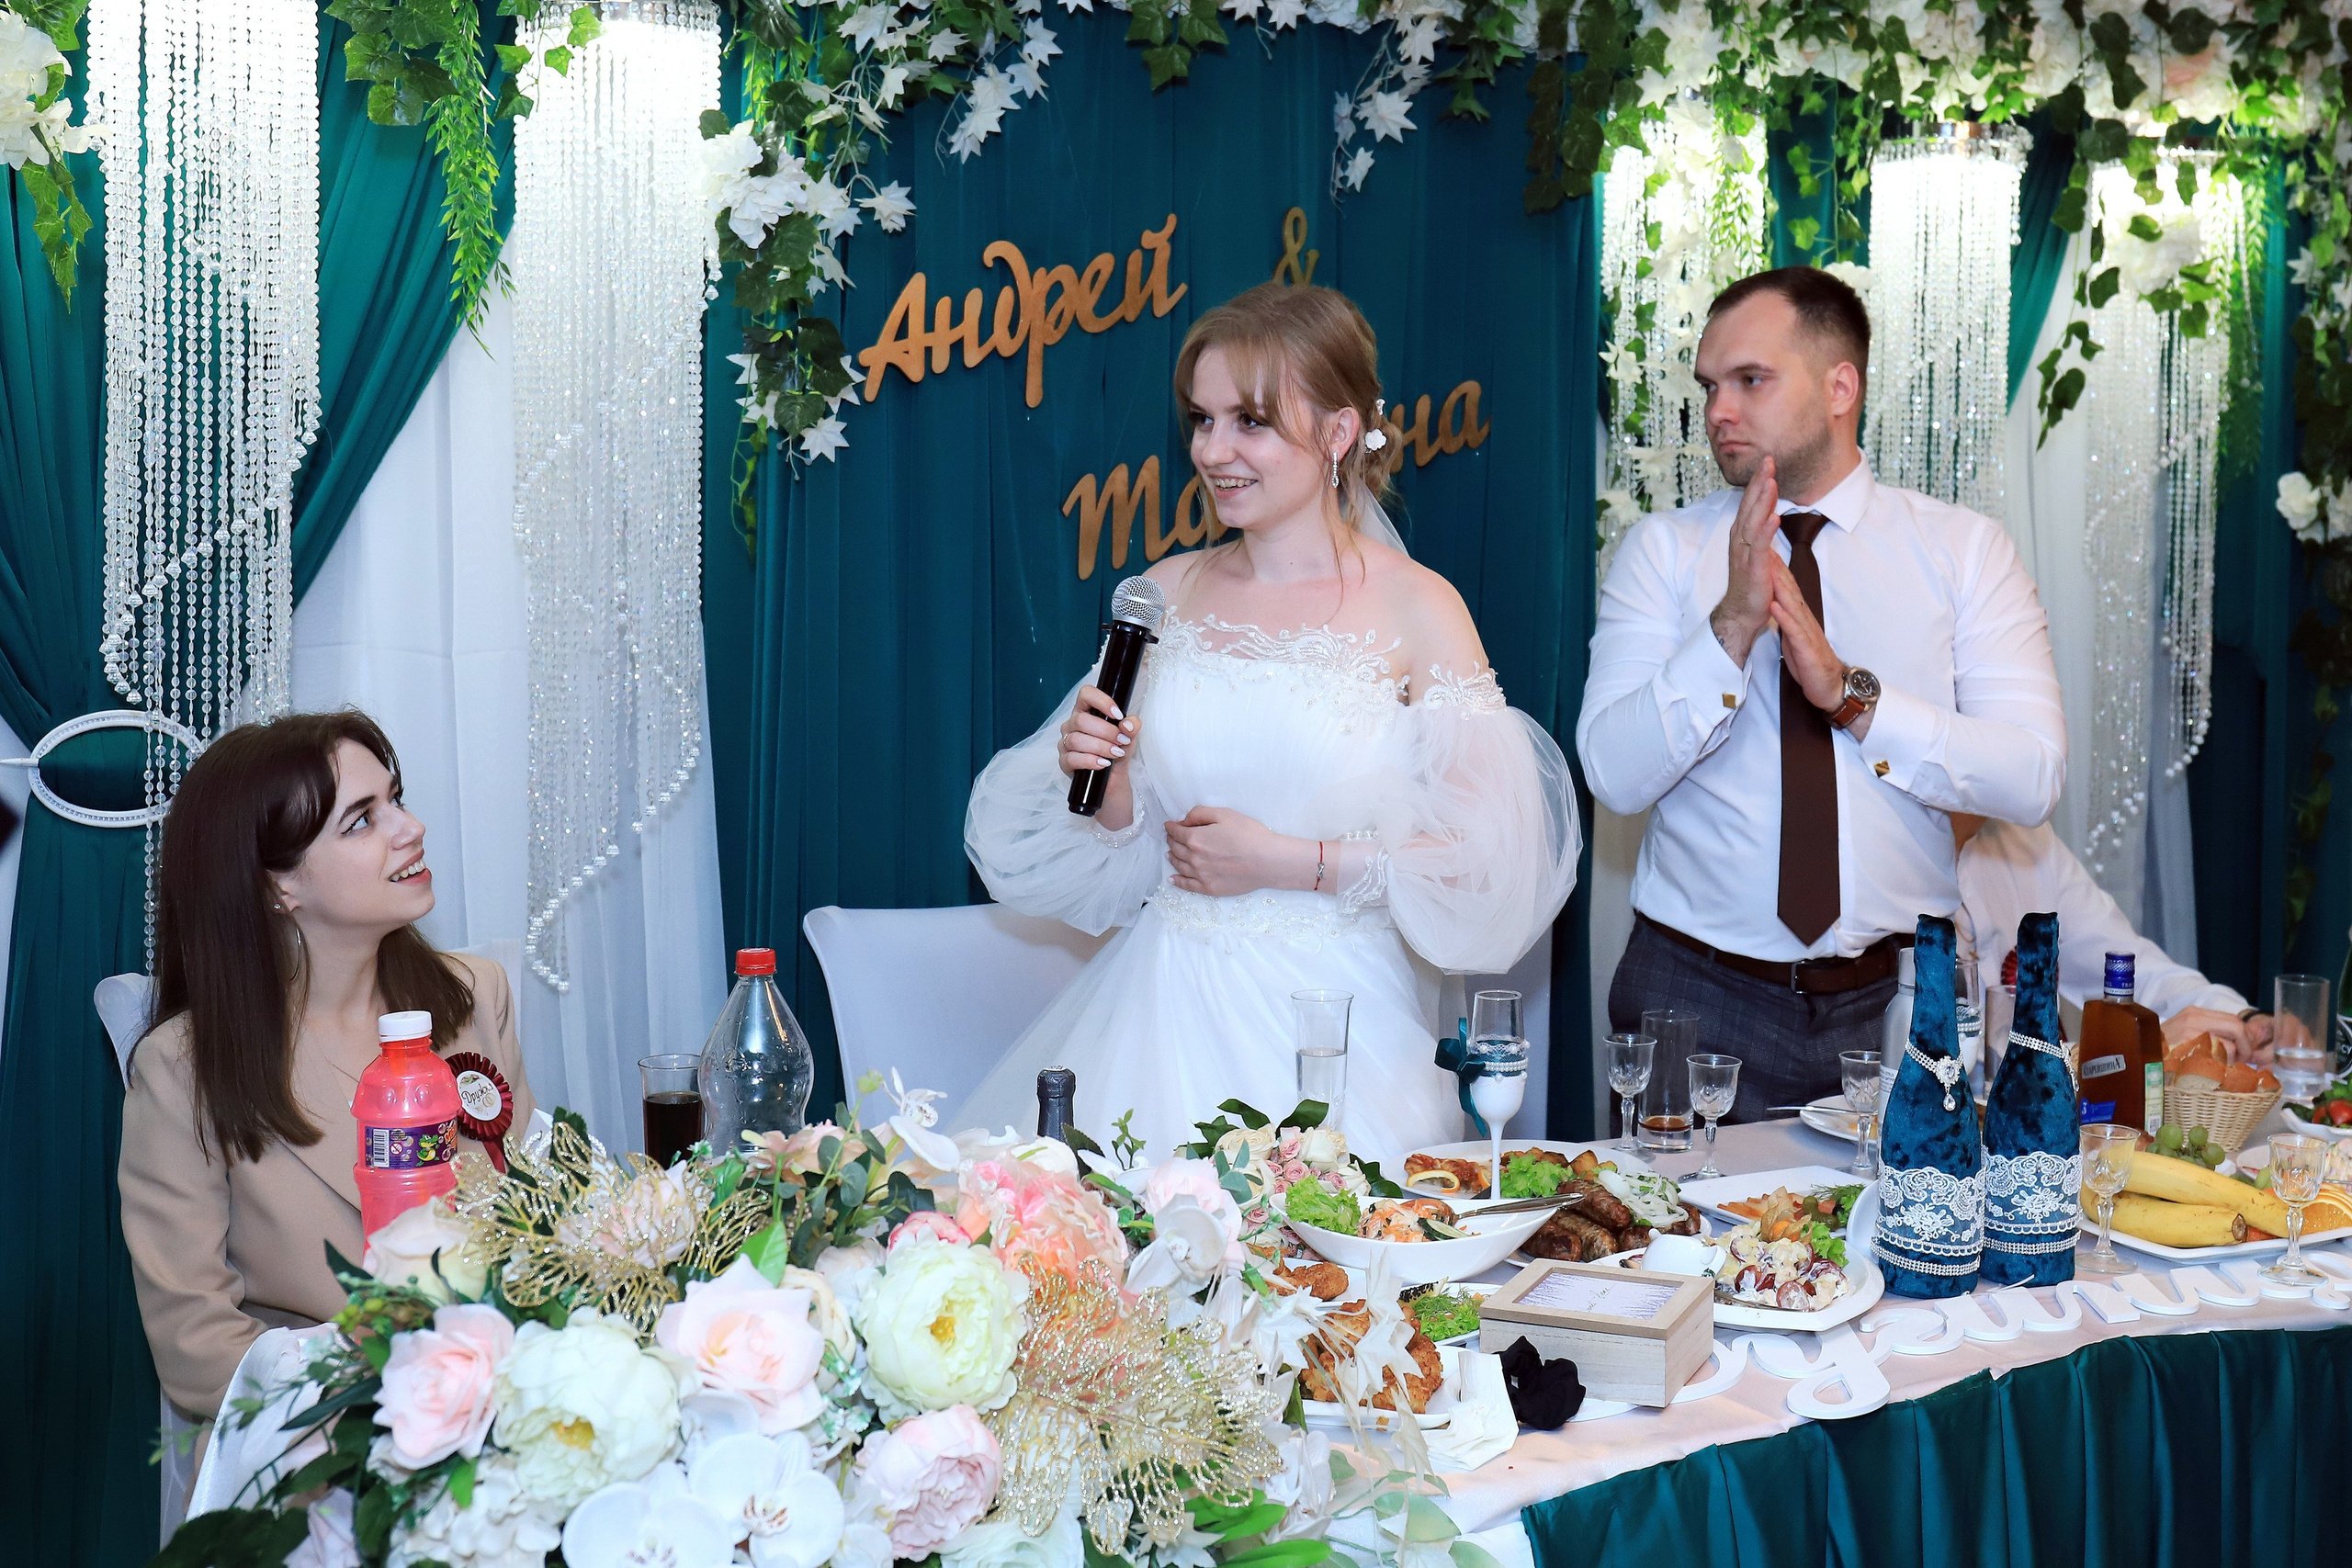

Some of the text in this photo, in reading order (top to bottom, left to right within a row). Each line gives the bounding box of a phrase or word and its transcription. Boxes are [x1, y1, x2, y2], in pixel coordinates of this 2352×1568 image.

[858, 206, 1320, 408] Андрей &
[2081, 1101, 2087, 1115] 3
